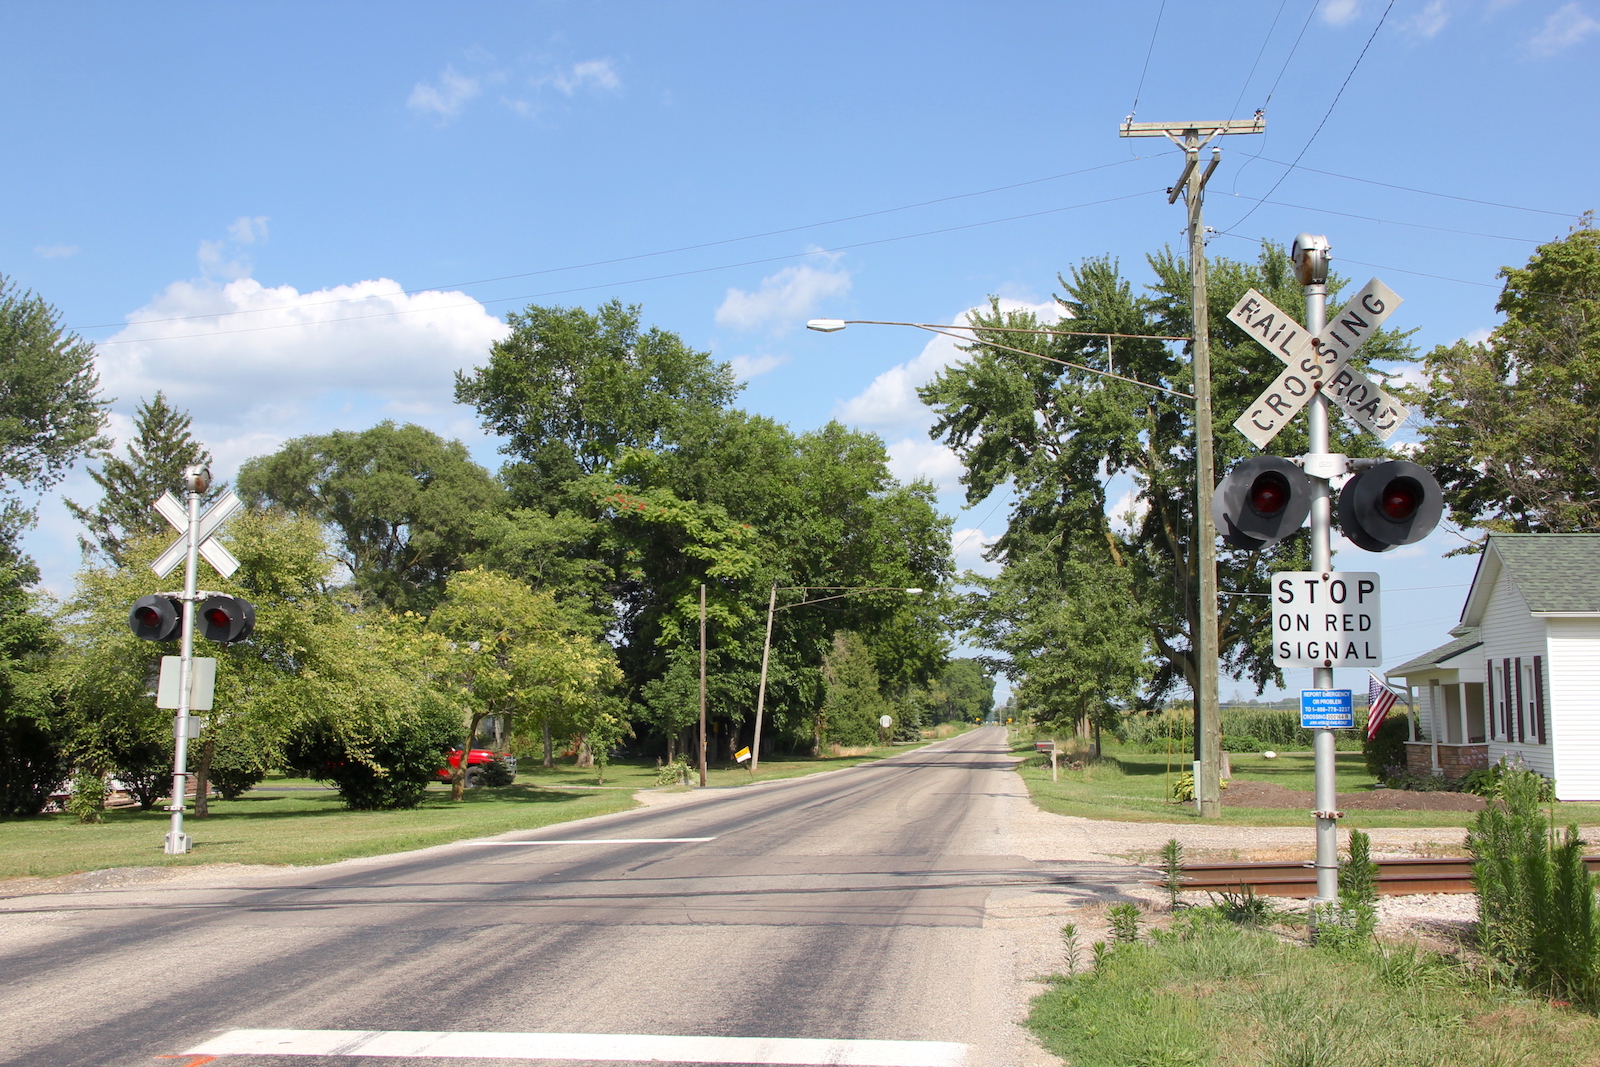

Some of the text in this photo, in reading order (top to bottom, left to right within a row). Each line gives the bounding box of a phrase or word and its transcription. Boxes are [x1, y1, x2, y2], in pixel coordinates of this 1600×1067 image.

[1237, 298, 1398, 430] RAIL ROAD
[1251, 294, 1385, 431] CROSSING
[1278, 580, 1374, 604] STOP
[1279, 614, 1371, 631] ON RED
[1280, 641, 1376, 659] SIGNAL
